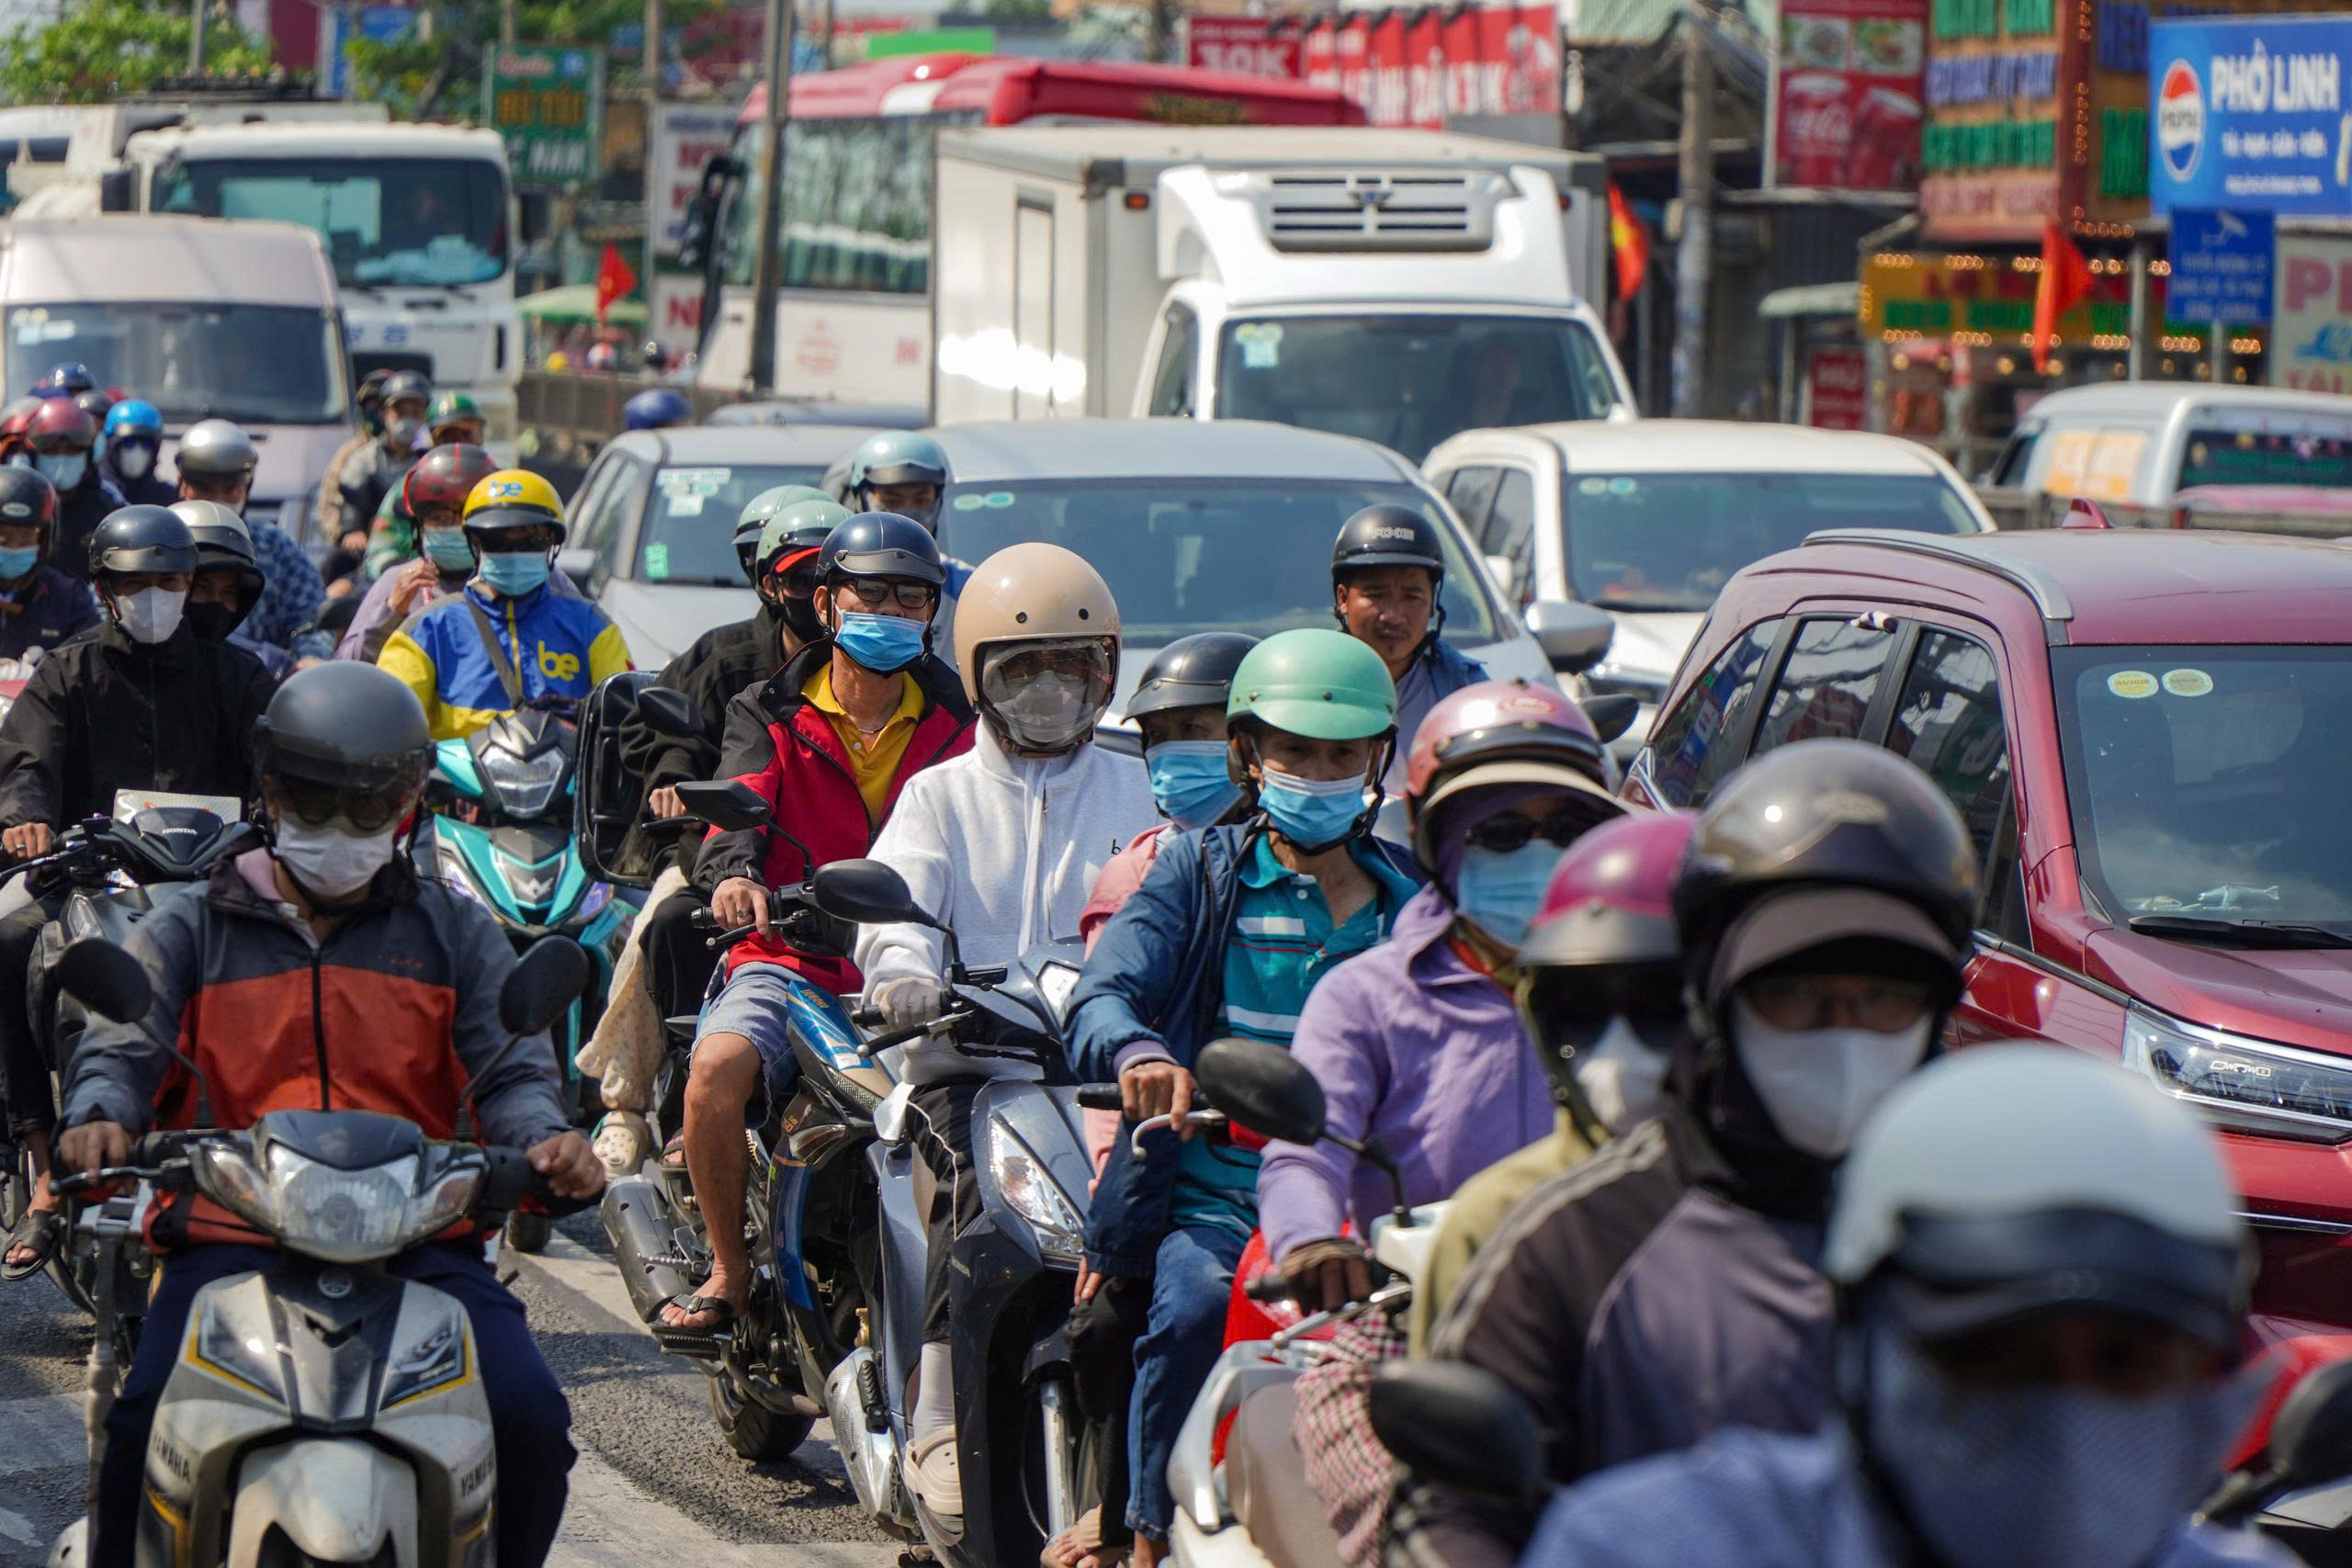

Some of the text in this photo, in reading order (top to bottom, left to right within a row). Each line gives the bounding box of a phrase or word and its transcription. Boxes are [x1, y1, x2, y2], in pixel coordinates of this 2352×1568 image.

[2273, 53, 2341, 111] LINH
[489, 480, 525, 498] be
[537, 639, 581, 682] be
[162, 827, 198, 835] HONDA
[153, 1435, 192, 1484] YAMAHA
